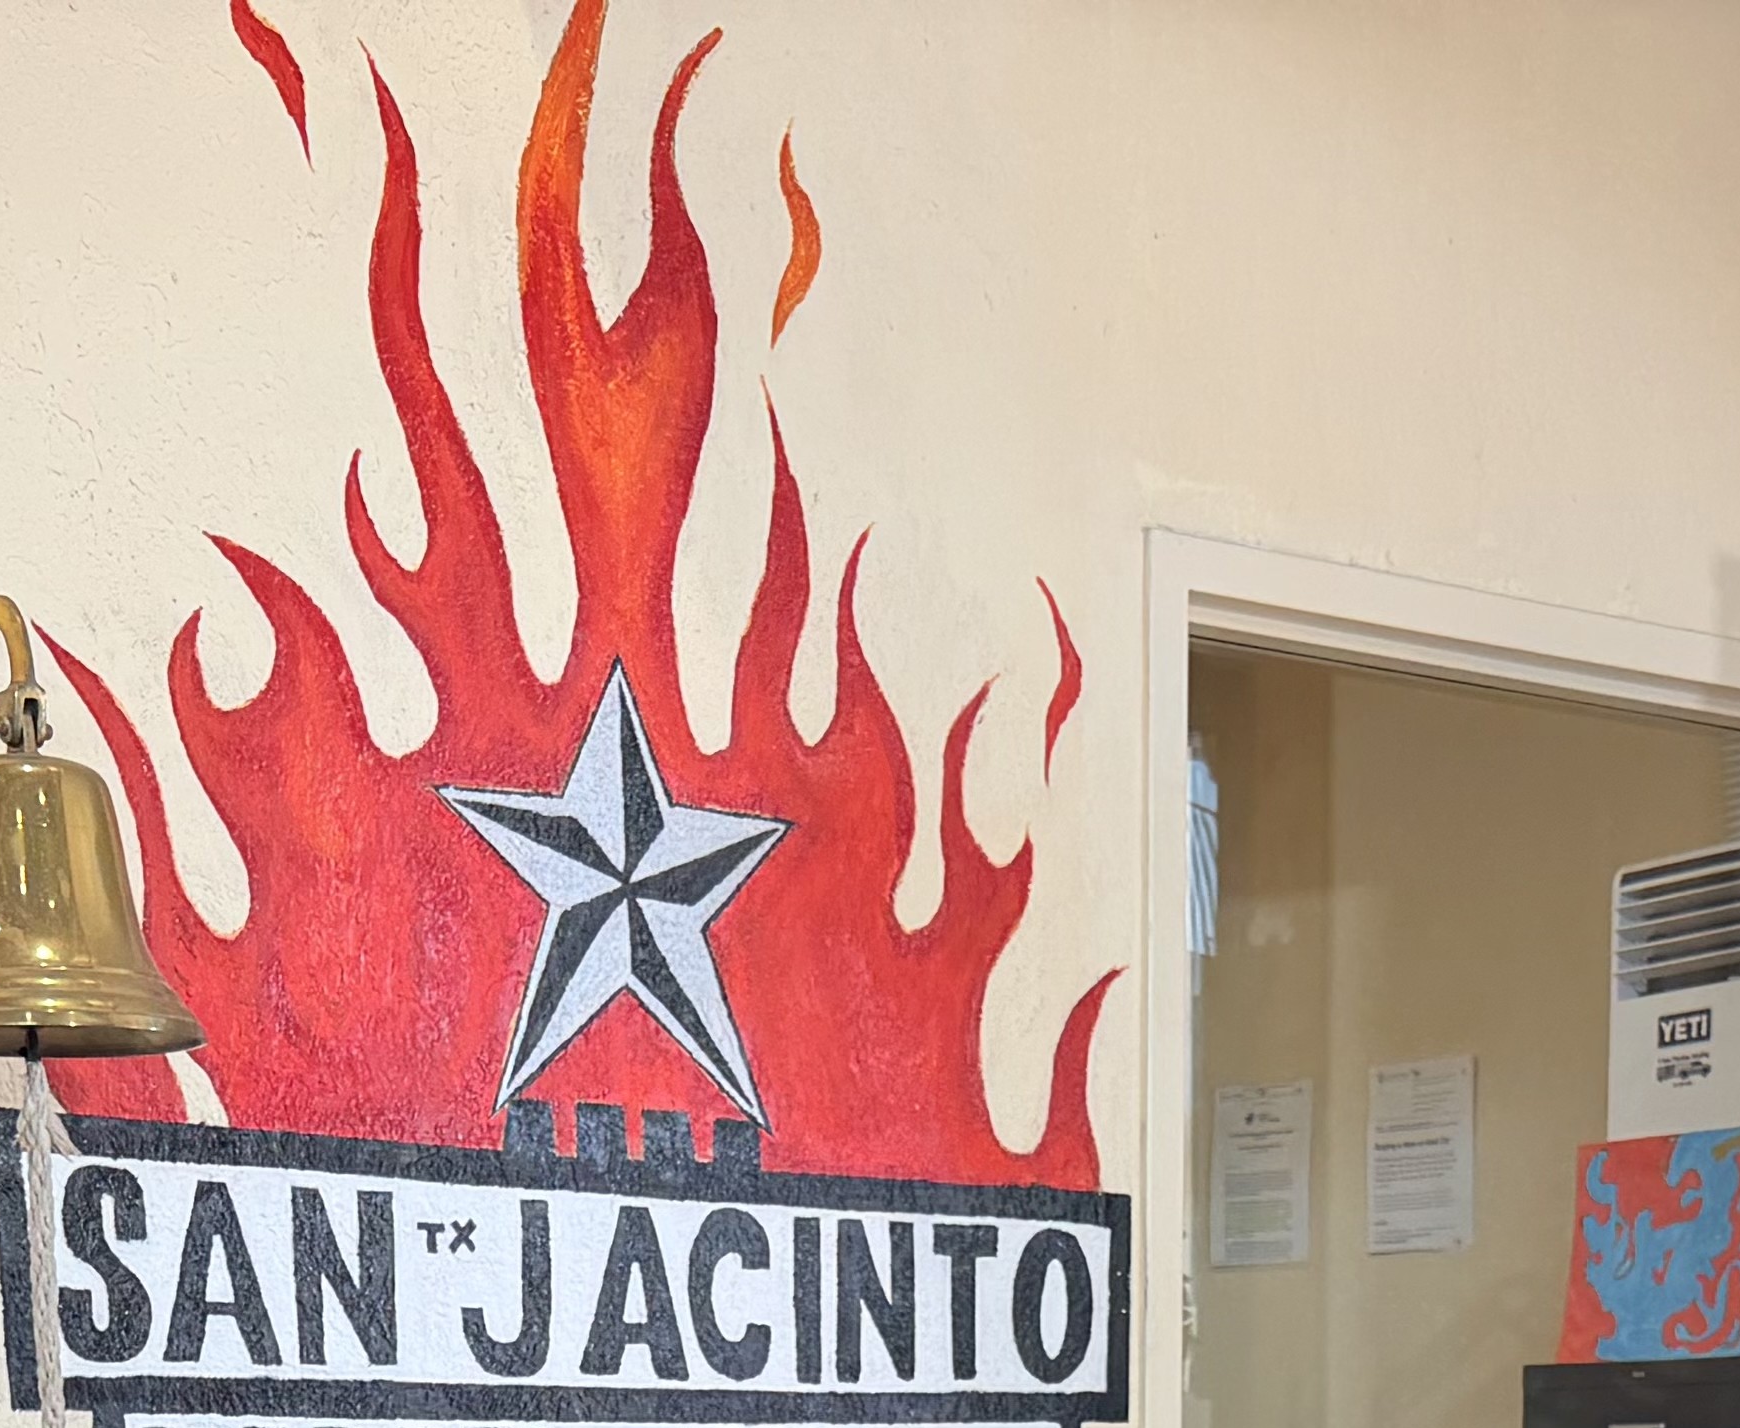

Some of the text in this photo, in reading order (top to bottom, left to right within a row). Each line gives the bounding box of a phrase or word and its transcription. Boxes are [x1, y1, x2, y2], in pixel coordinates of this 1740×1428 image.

[1660, 1013, 1708, 1043] YETI
[60, 1165, 398, 1365] SAN
[416, 1219, 476, 1255] TX
[460, 1199, 1093, 1386] JACINTO
